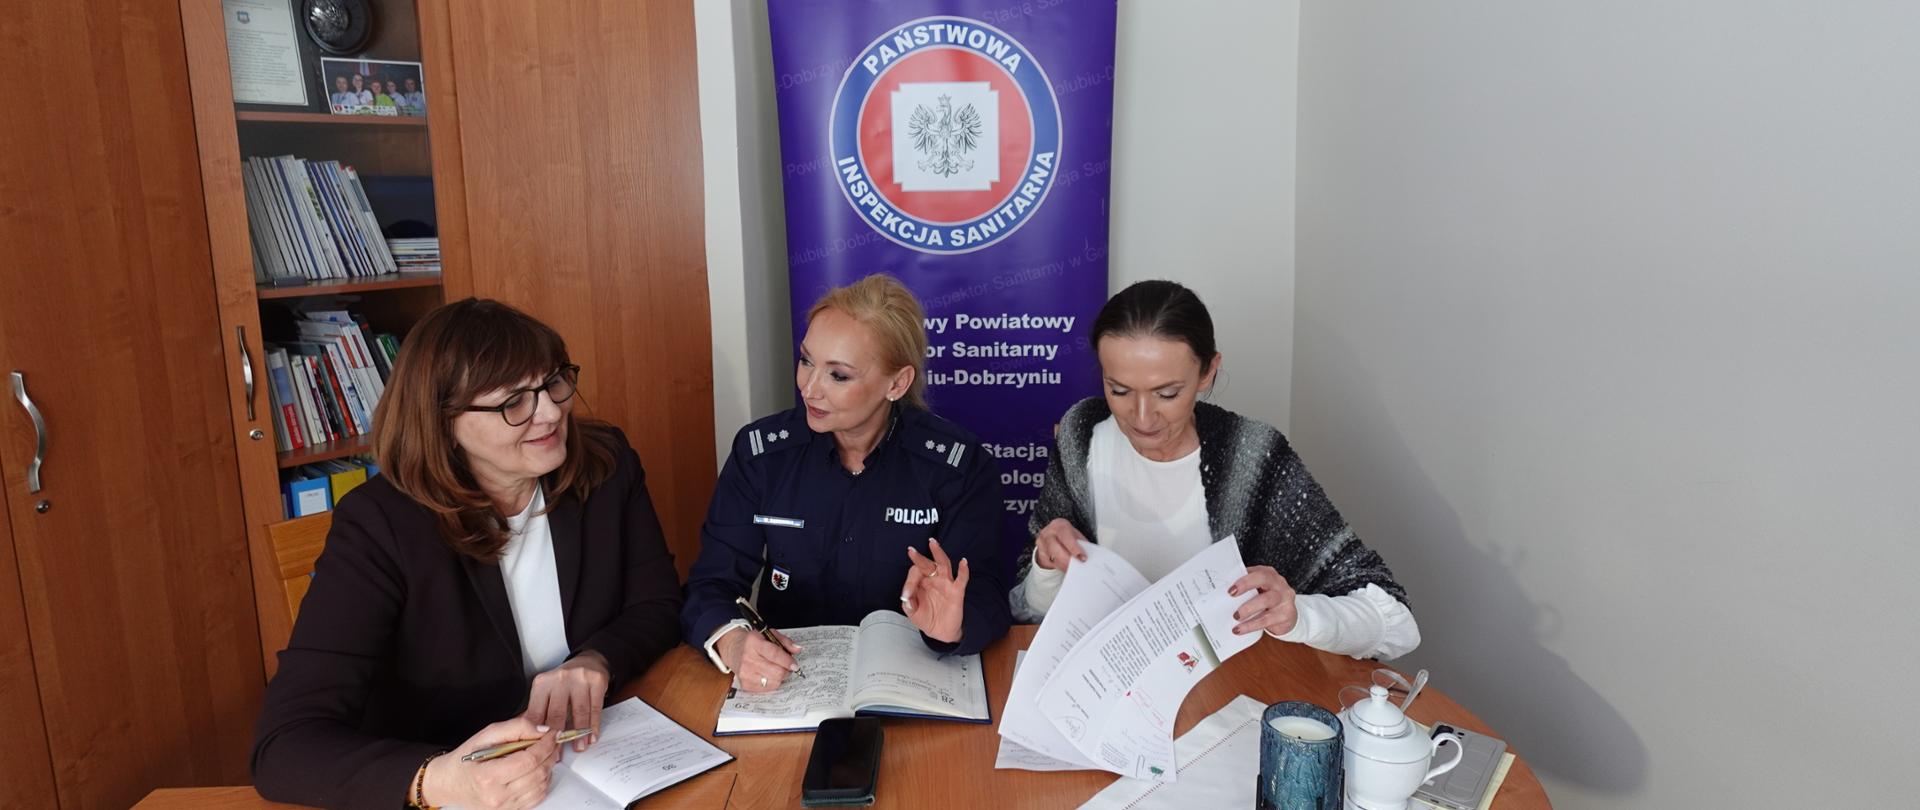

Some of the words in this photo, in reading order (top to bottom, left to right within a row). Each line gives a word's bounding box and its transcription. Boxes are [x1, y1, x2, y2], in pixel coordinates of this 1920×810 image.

[863, 23, 1022, 76] PAŃSTWOWA
[838, 156, 943, 245] INSPEKCJA
[950, 151, 1055, 246] SANITARNA
[956, 314, 1075, 333] Powiatowy
[952, 341, 1058, 360] Sanitarny
[927, 369, 1062, 388] iu-Dobrzyniu
[1000, 469, 1045, 488] olog
[885, 507, 939, 525] POLICJA
